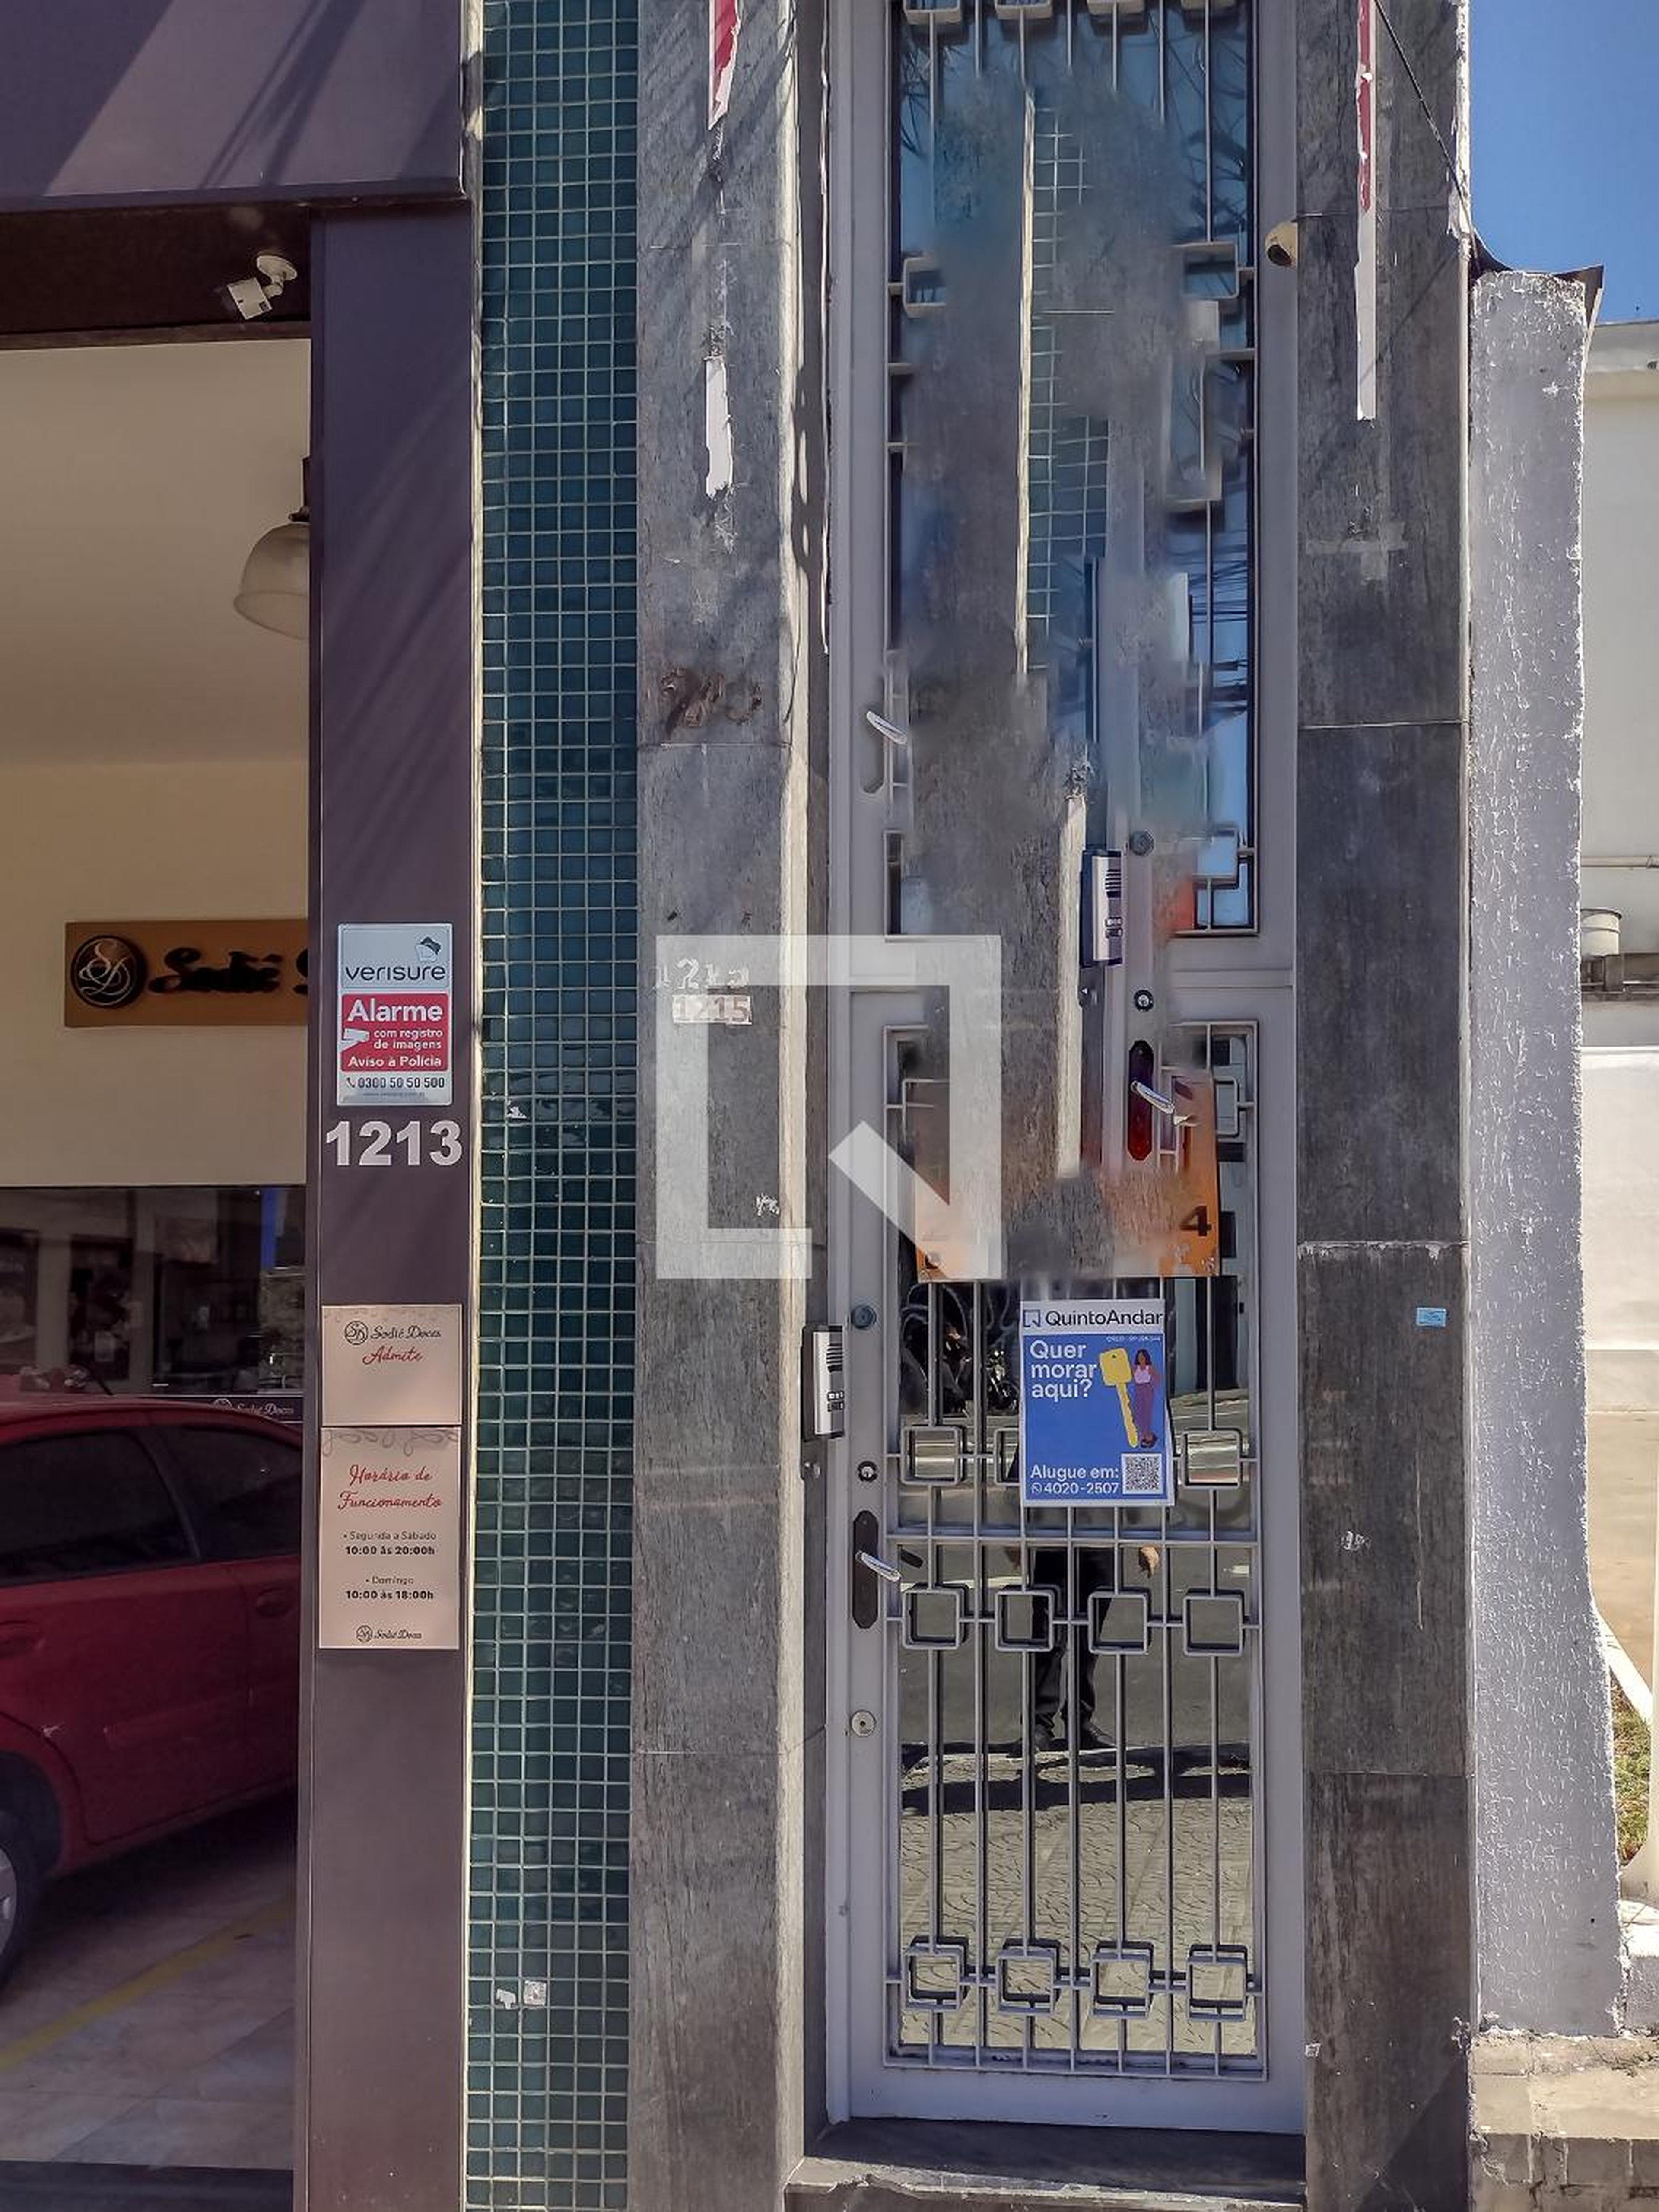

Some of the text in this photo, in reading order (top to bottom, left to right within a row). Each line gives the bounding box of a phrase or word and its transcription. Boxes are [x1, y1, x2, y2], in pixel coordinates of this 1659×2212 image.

[346, 965, 446, 981] verisure
[347, 999, 442, 1021] Alarme
[400, 1028, 443, 1039] registro
[374, 1039, 441, 1051] de imagens
[348, 1056, 384, 1066] Aviso
[400, 1055, 441, 1066] Polícia
[358, 1077, 445, 1088] 0300 50 50 500
[326, 1121, 462, 1166] 1213
[1046, 1309, 1163, 1327] QuintoAndar
[1030, 1340, 1086, 1359] Quer
[1031, 1363, 1097, 1378] morar
[1031, 1378, 1093, 1402] aqui?
[350, 1464, 433, 1486] Horário de
[1030, 1464, 1119, 1482] Alugue em:
[1044, 1482, 1119, 1494] 4020-2507
[338, 1490, 443, 1510] Funcionamento
[346, 1545, 377, 1554] 10:00
[395, 1545, 435, 1554] 20:00h
[346, 1590, 378, 1599] 10:00
[396, 1590, 433, 1599] 18:00h
